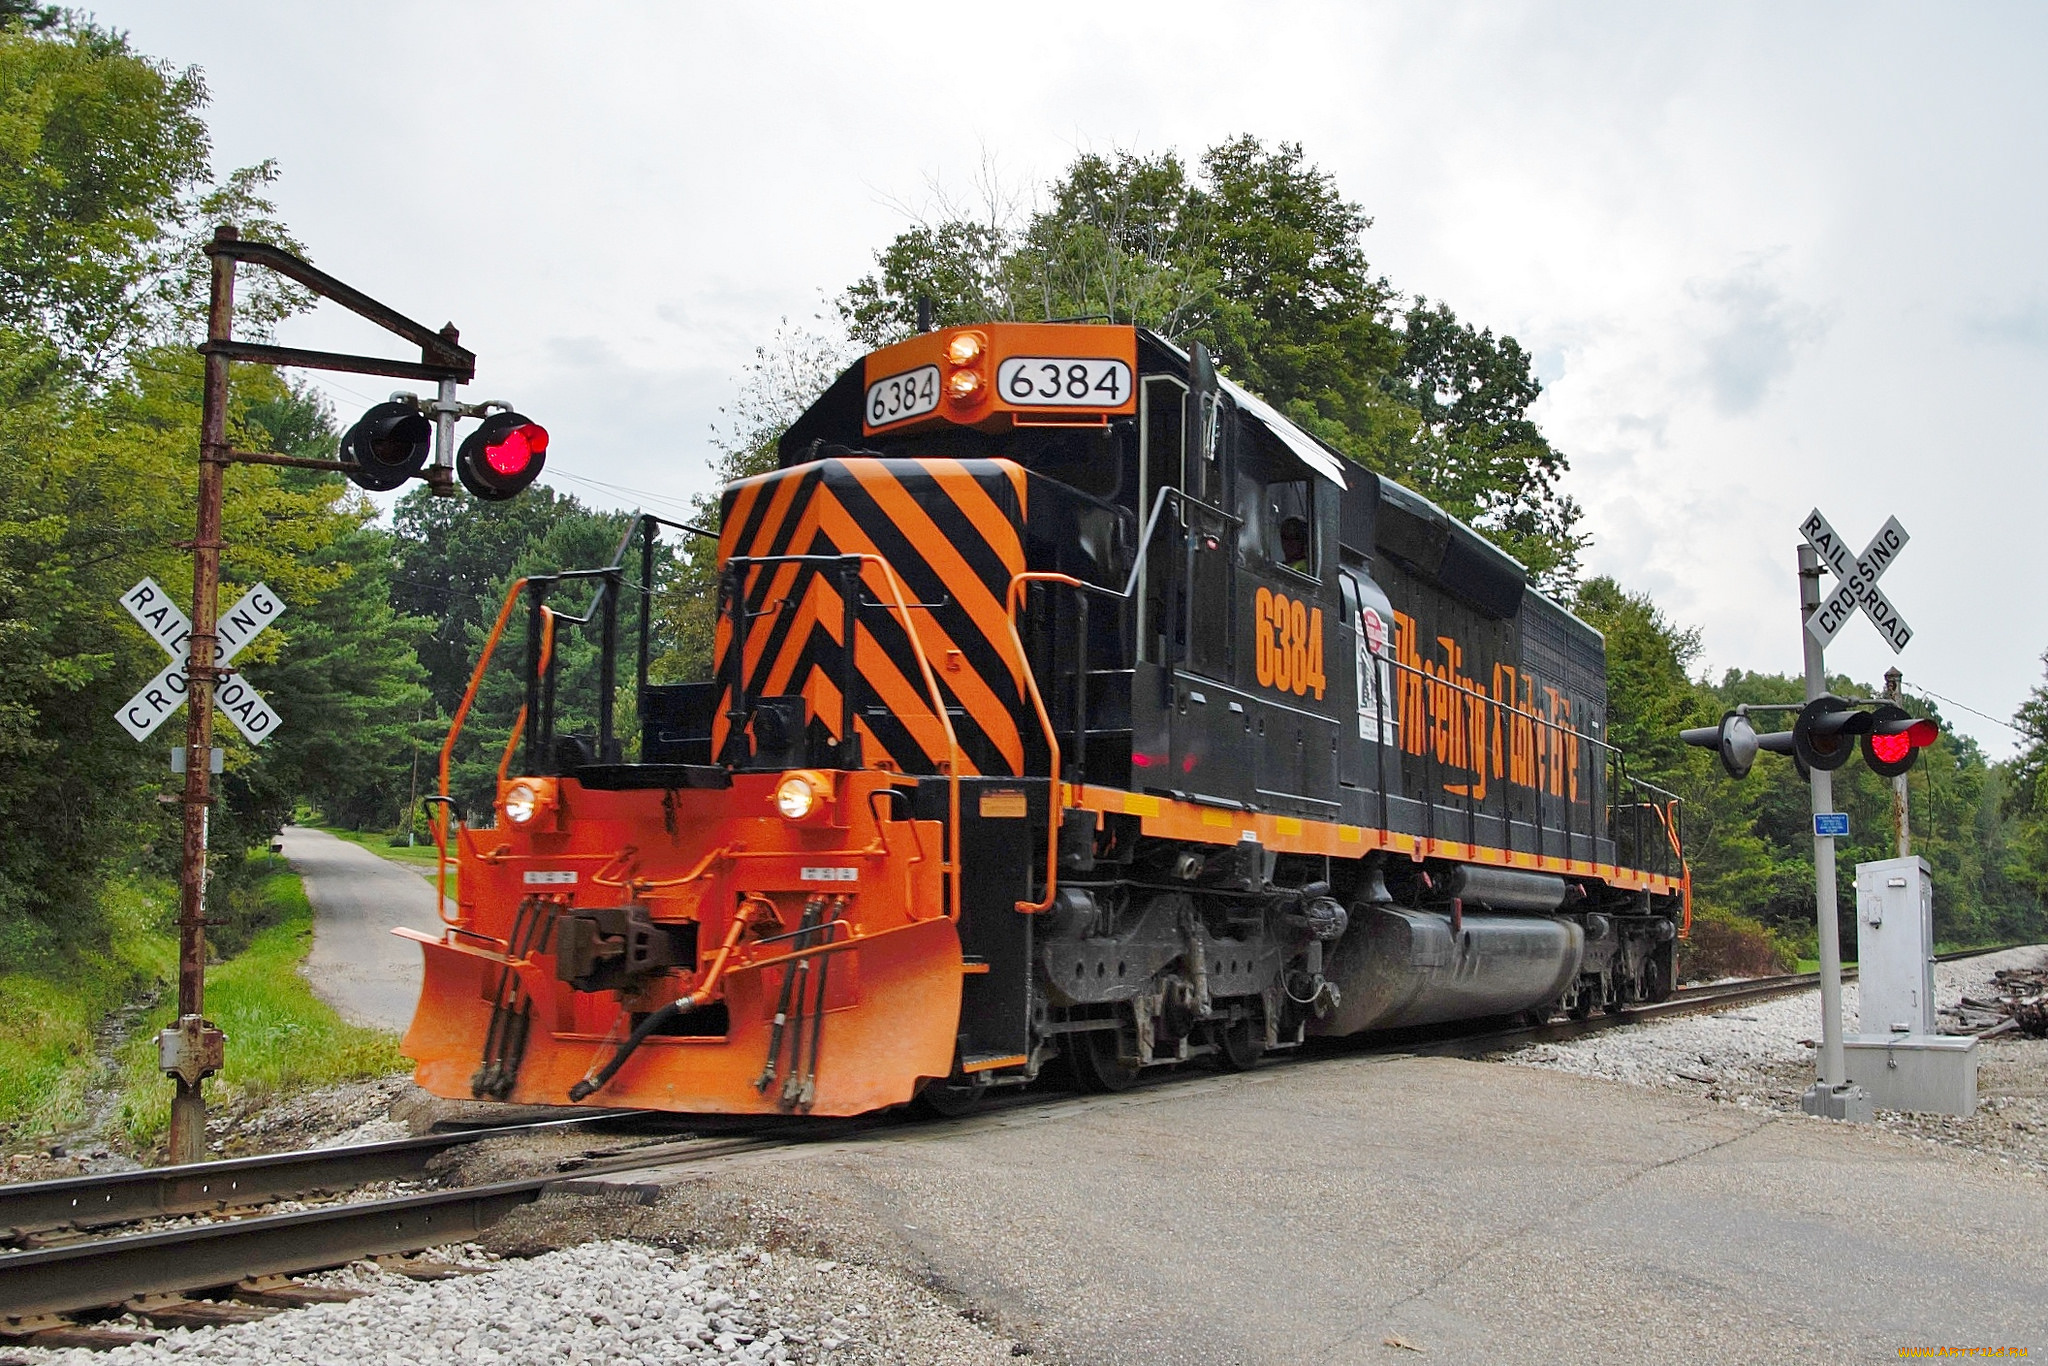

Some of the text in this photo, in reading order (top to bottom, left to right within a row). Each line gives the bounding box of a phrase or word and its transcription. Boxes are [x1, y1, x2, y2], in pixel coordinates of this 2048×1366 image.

[872, 371, 933, 420] 6384
[1010, 364, 1119, 400] 6384
[1805, 514, 1910, 649] RAIL ROAD
[1818, 529, 1900, 634] CROSSING
[130, 586, 270, 733] RAIL ROAD
[1255, 586, 1326, 700] 6384
[1393, 609, 1486, 800] Wheeling
[1491, 661, 1504, 780] &
[1501, 665, 1546, 792] Lake
